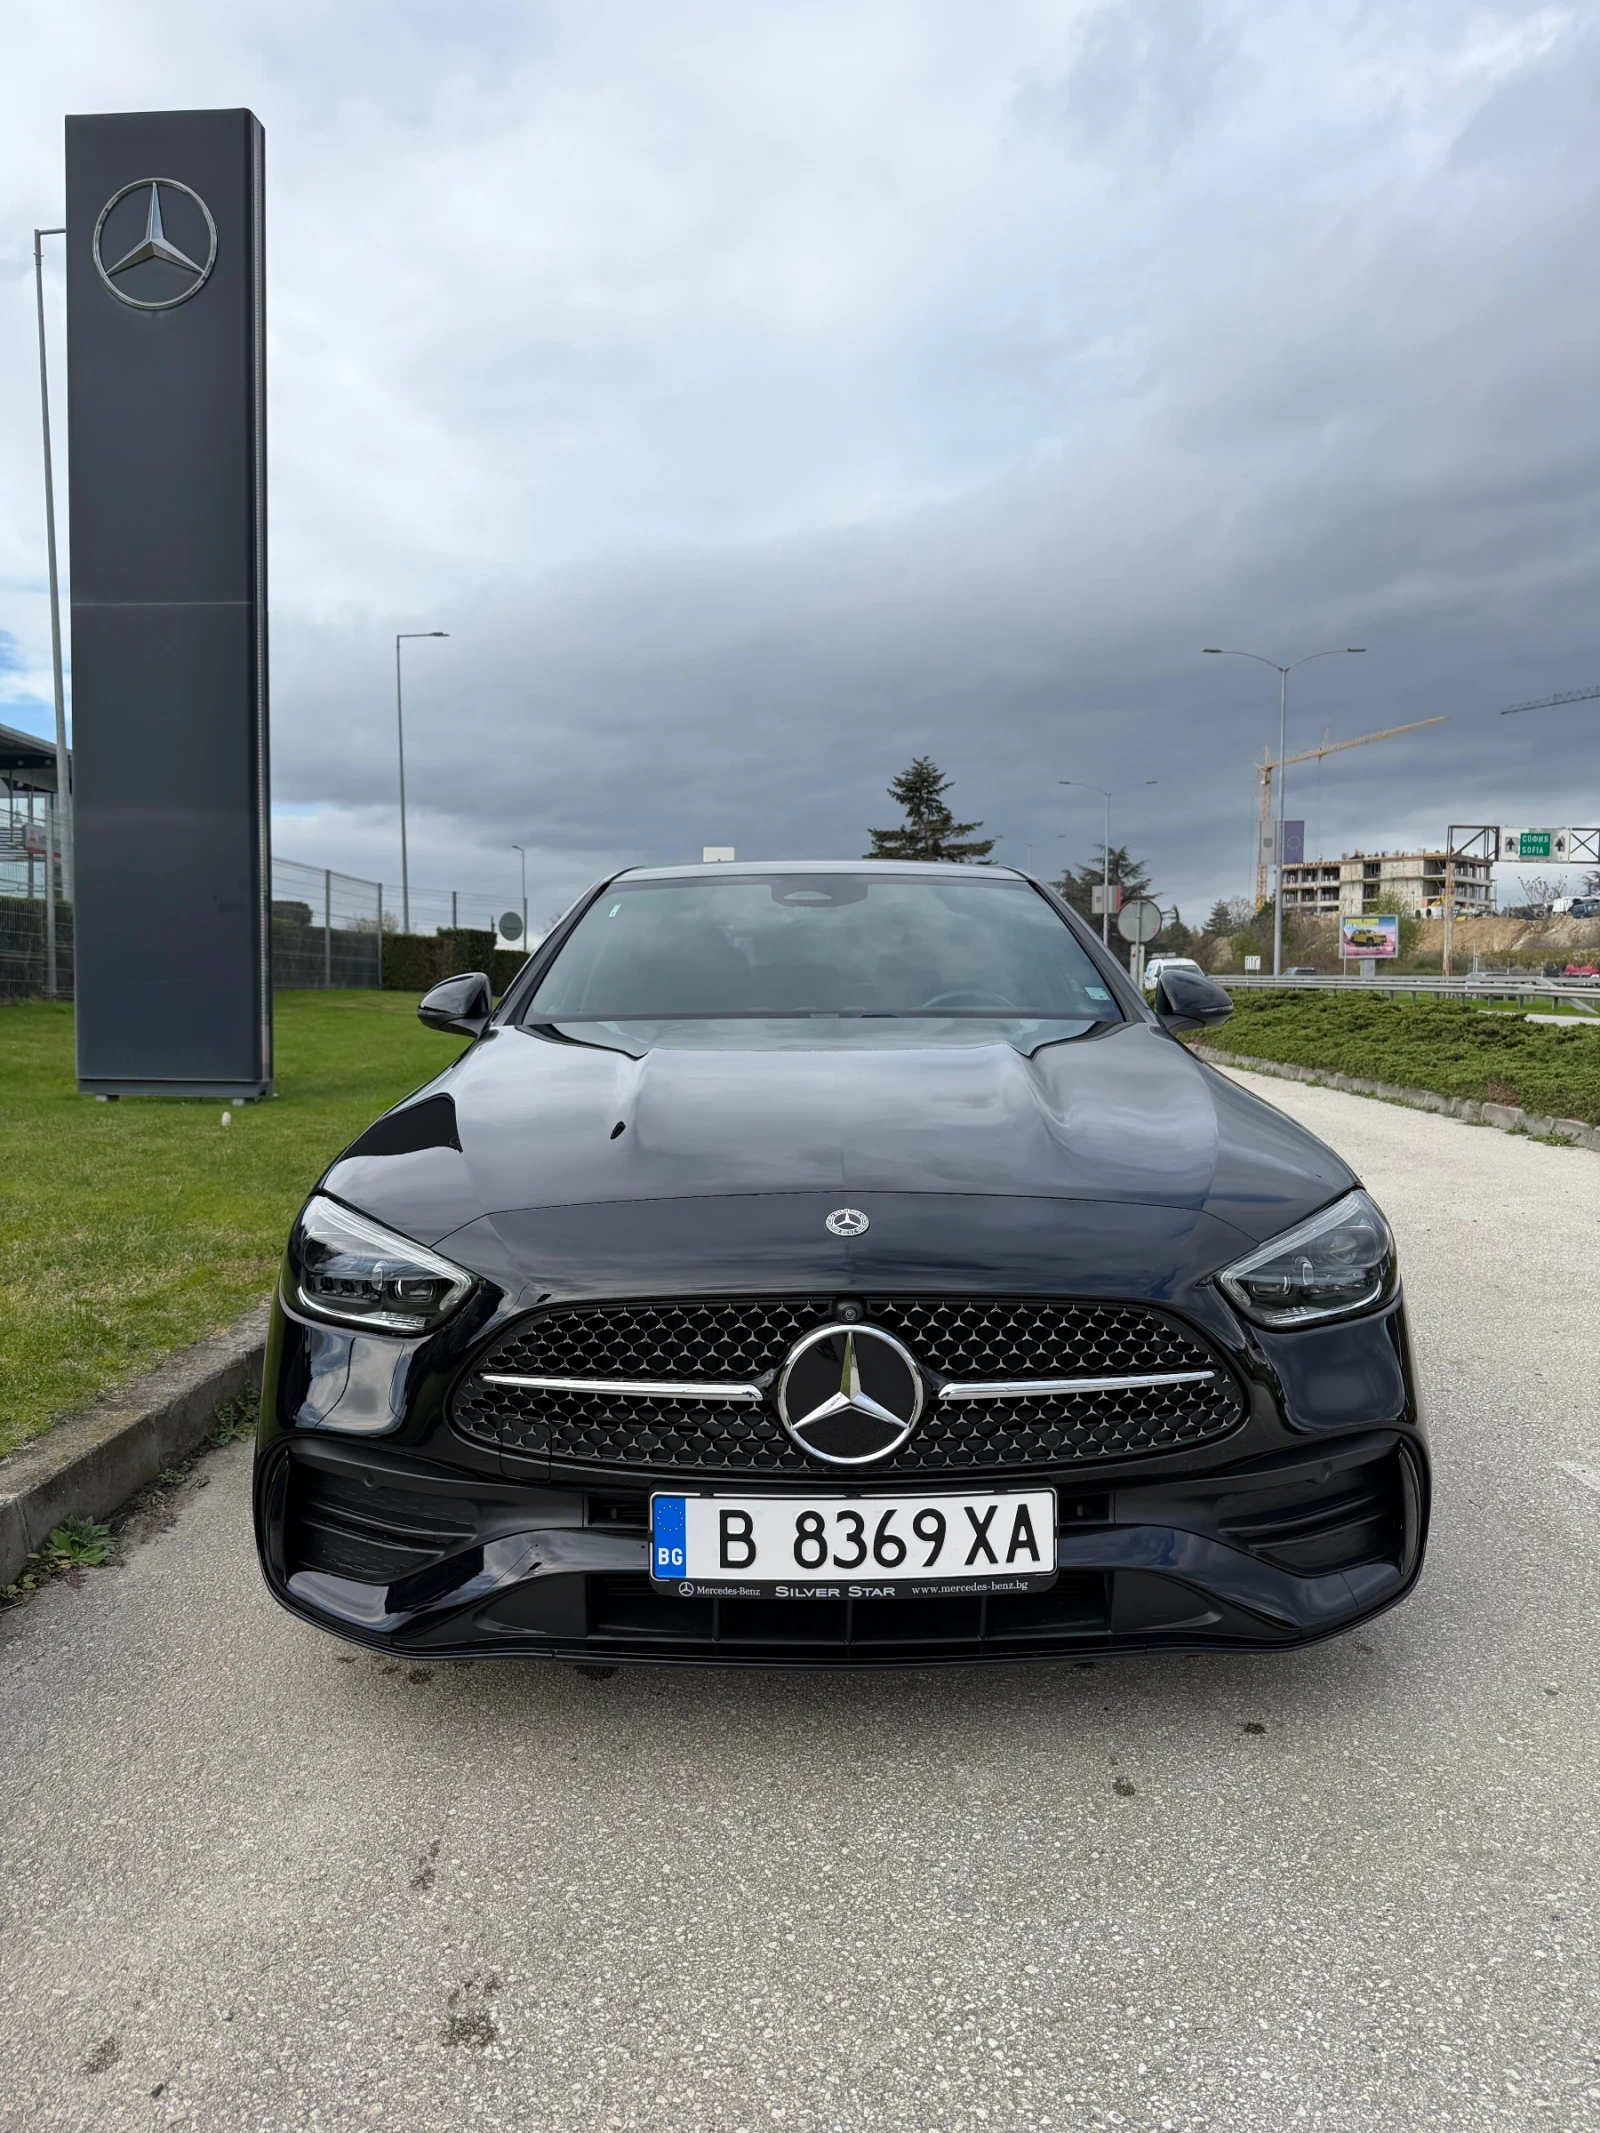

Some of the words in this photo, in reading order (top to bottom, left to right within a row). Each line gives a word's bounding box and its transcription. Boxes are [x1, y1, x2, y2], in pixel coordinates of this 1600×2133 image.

[1522, 835, 1549, 843] СОФИЯ
[1522, 846, 1544, 854] SOFIA
[719, 1509, 757, 1568] B
[793, 1508, 947, 1569] 8369
[963, 1503, 1041, 1566] XA
[657, 1547, 683, 1566] BG
[696, 1585, 761, 1596] Mercedes-Benz
[911, 1580, 1029, 1594] www.mercedes-benz.bg
